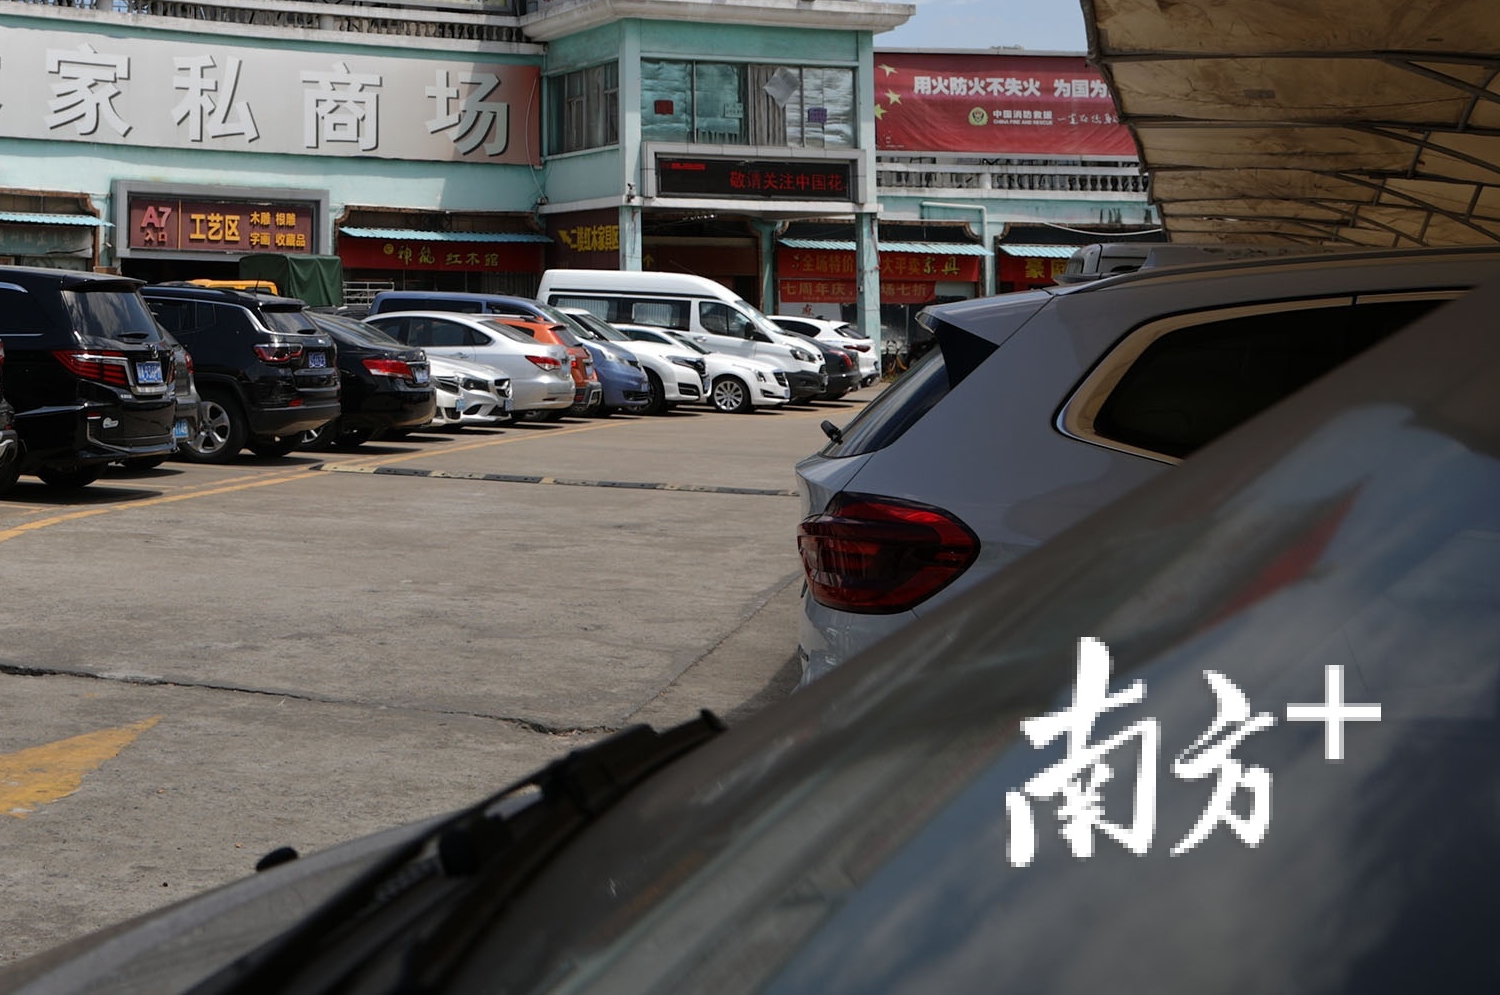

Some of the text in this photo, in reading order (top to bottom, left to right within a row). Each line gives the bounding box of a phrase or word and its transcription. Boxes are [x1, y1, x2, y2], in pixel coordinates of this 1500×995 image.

[913, 76, 1111, 99] 用火防火不失火 为国为
[993, 110, 1053, 120] 中国消防救援
[729, 170, 848, 192] 敬请关注中国花
[140, 205, 172, 228] A7
[189, 212, 240, 241] 工艺区
[250, 211, 296, 227] 木雕 根雕
[144, 231, 168, 242] 入口
[250, 232, 306, 248] 字画 收藏品
[802, 253, 854, 273] 全场特价
